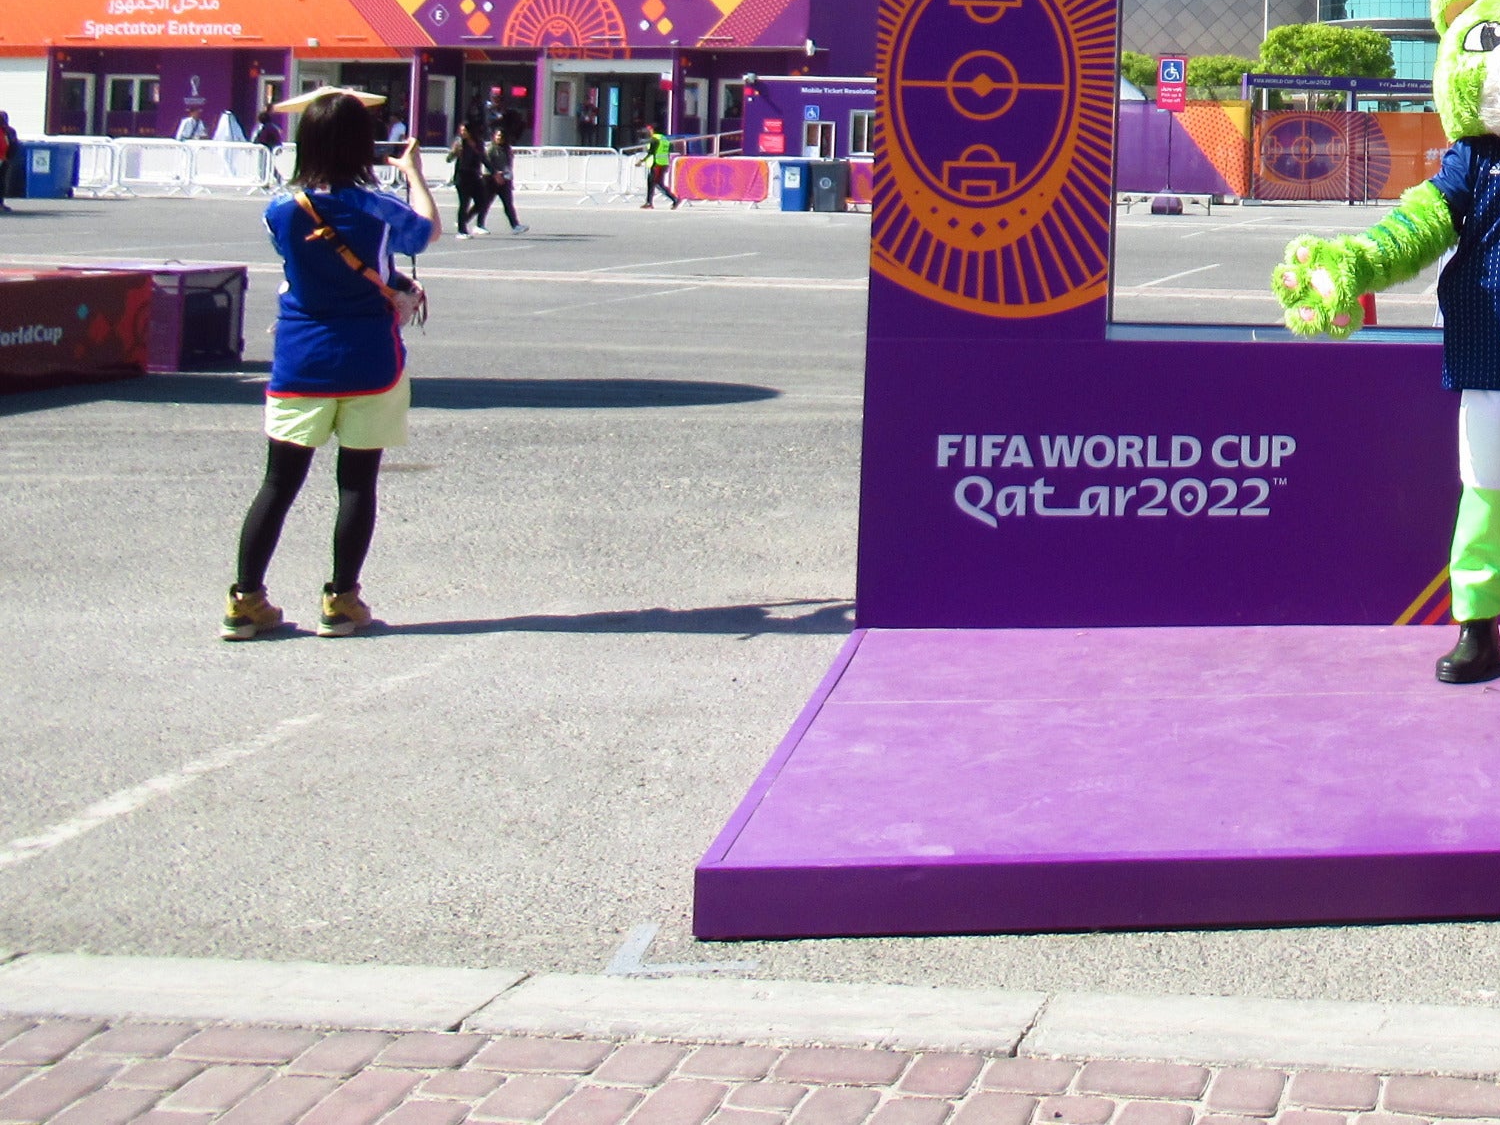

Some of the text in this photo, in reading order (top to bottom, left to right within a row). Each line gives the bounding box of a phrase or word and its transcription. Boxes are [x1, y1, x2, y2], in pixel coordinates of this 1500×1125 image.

[435, 10, 443, 20] E
[84, 20, 241, 38] Spectator Entrance
[937, 434, 1297, 468] FIFA WORLD CUP
